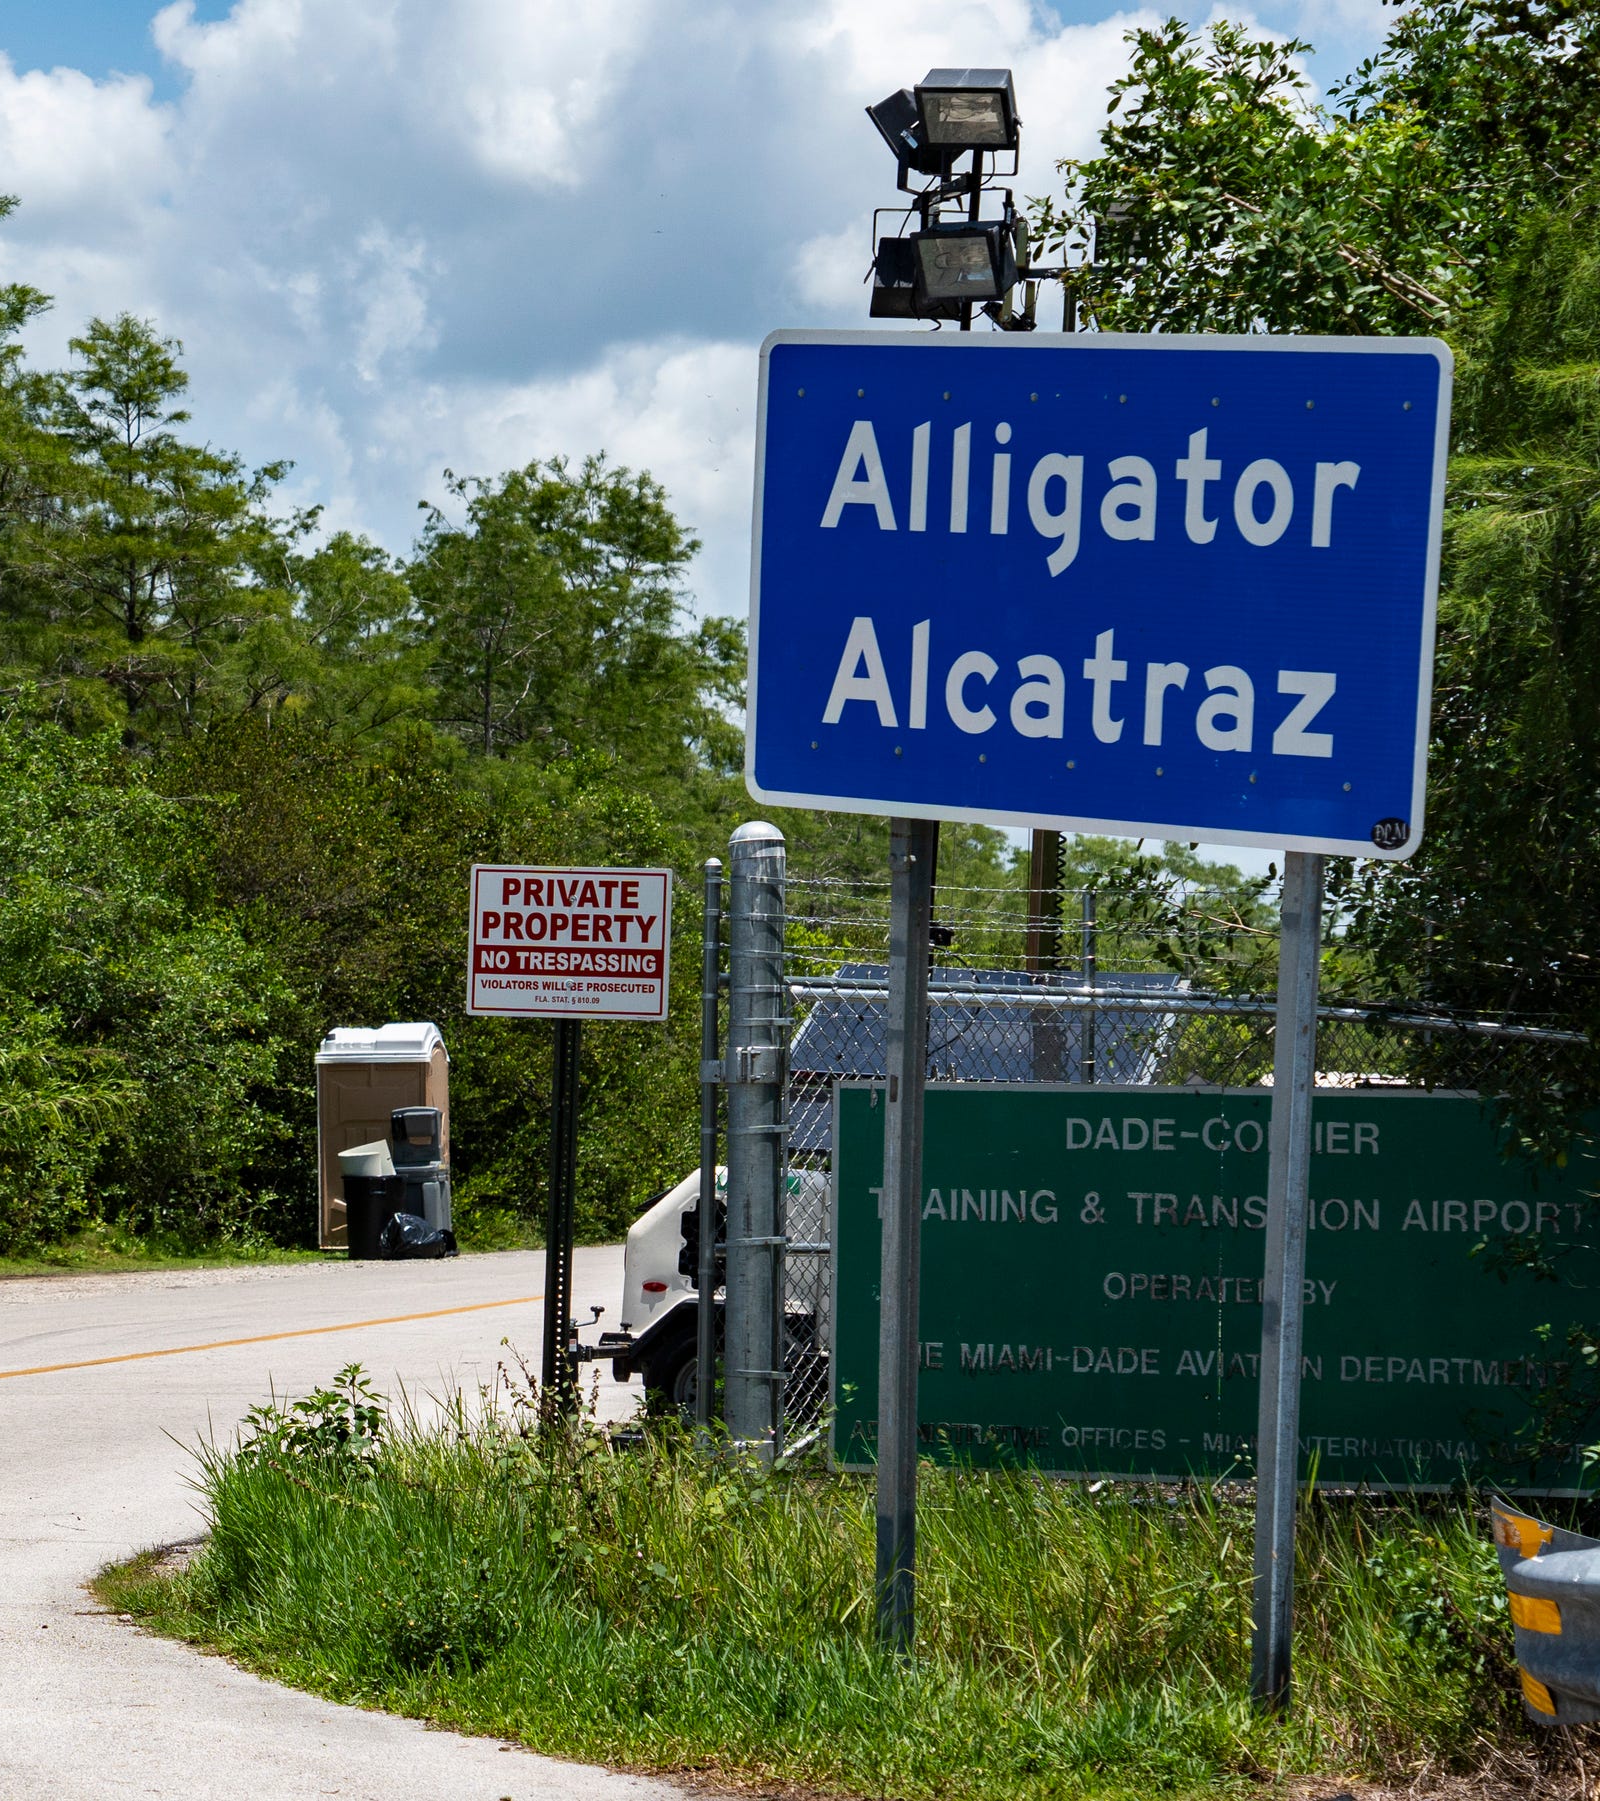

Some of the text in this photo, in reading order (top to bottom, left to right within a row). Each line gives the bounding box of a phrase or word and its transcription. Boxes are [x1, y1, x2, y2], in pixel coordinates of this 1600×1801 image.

[819, 419, 1362, 578] Alligator
[821, 616, 1338, 759] Alcatraz
[502, 877, 640, 909] PRIVATE
[481, 911, 657, 944] PROPERTY
[480, 950, 657, 973] NO TRESPASSING
[481, 979, 656, 994] VIOLATORS WILL BE PROSECUTED
[534, 995, 549, 1003] FLA.
[551, 996, 570, 1004] STAT.
[577, 997, 600, 1005] 810.09
[1065, 1117, 1380, 1154] DADE-COIER
[868, 1187, 1584, 1234] TAINING & TRANSION AIRPORT
[1103, 1272, 1338, 1305] OPERATE BY
[960, 1342, 1160, 1375] MIAMI-DADE
[1176, 1350, 1322, 1381] AVIATN
[850, 1420, 1050, 1447] ADNISTRATIVE
[1061, 1426, 1167, 1450] OFFICES
[1203, 1432, 1259, 1454] MIAM
[1297, 1436, 1480, 1462] NTERNATIONAL
